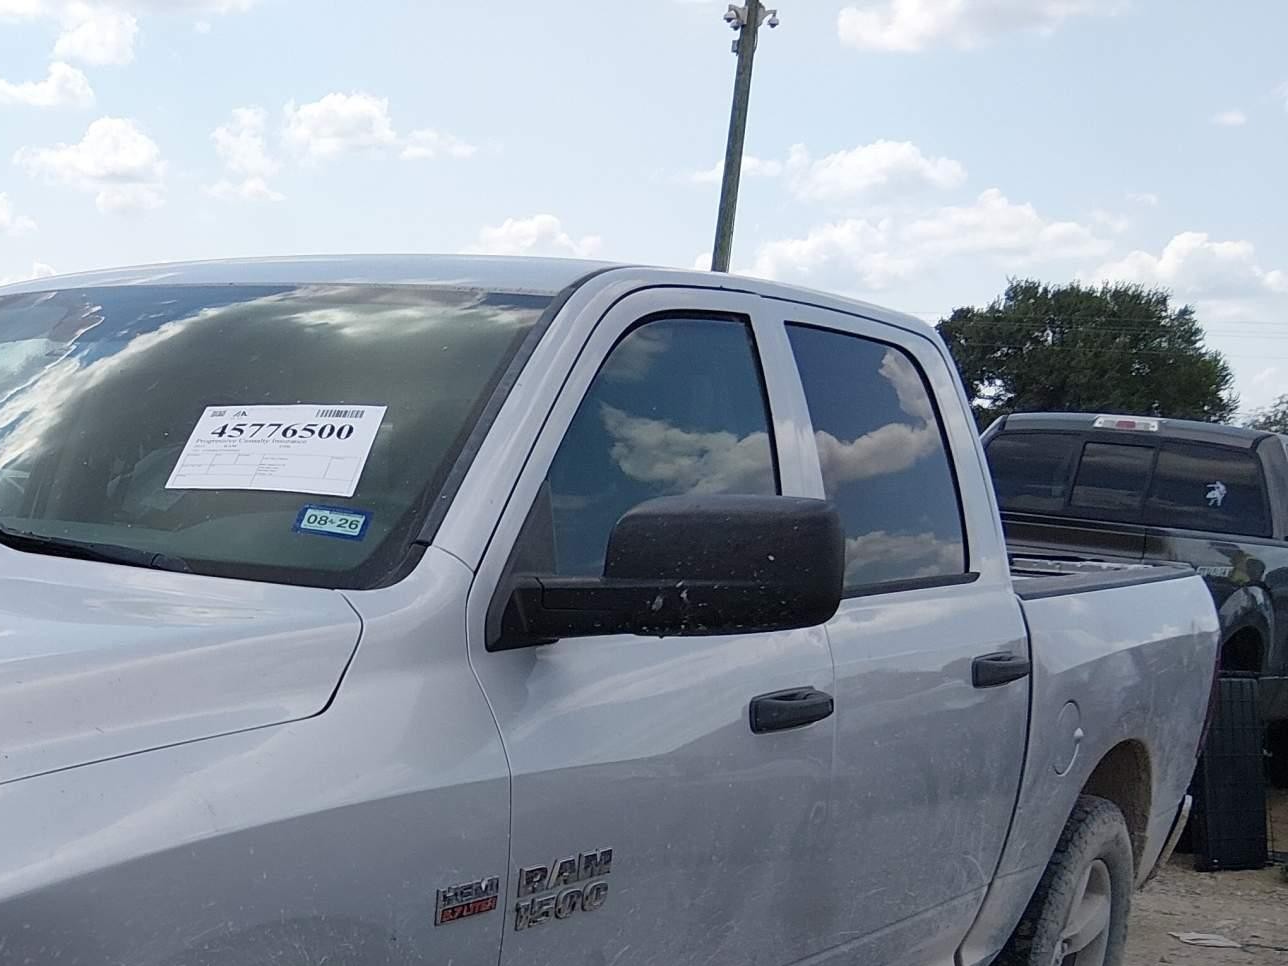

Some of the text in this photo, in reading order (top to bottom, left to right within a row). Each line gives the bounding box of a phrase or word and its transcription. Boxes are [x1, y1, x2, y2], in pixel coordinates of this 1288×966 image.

[210, 423, 354, 440] 45776500
[306, 513, 361, 531] 08 26
[518, 848, 613, 898] RAM
[436, 876, 500, 914] HEMI
[515, 879, 609, 931] 1500
